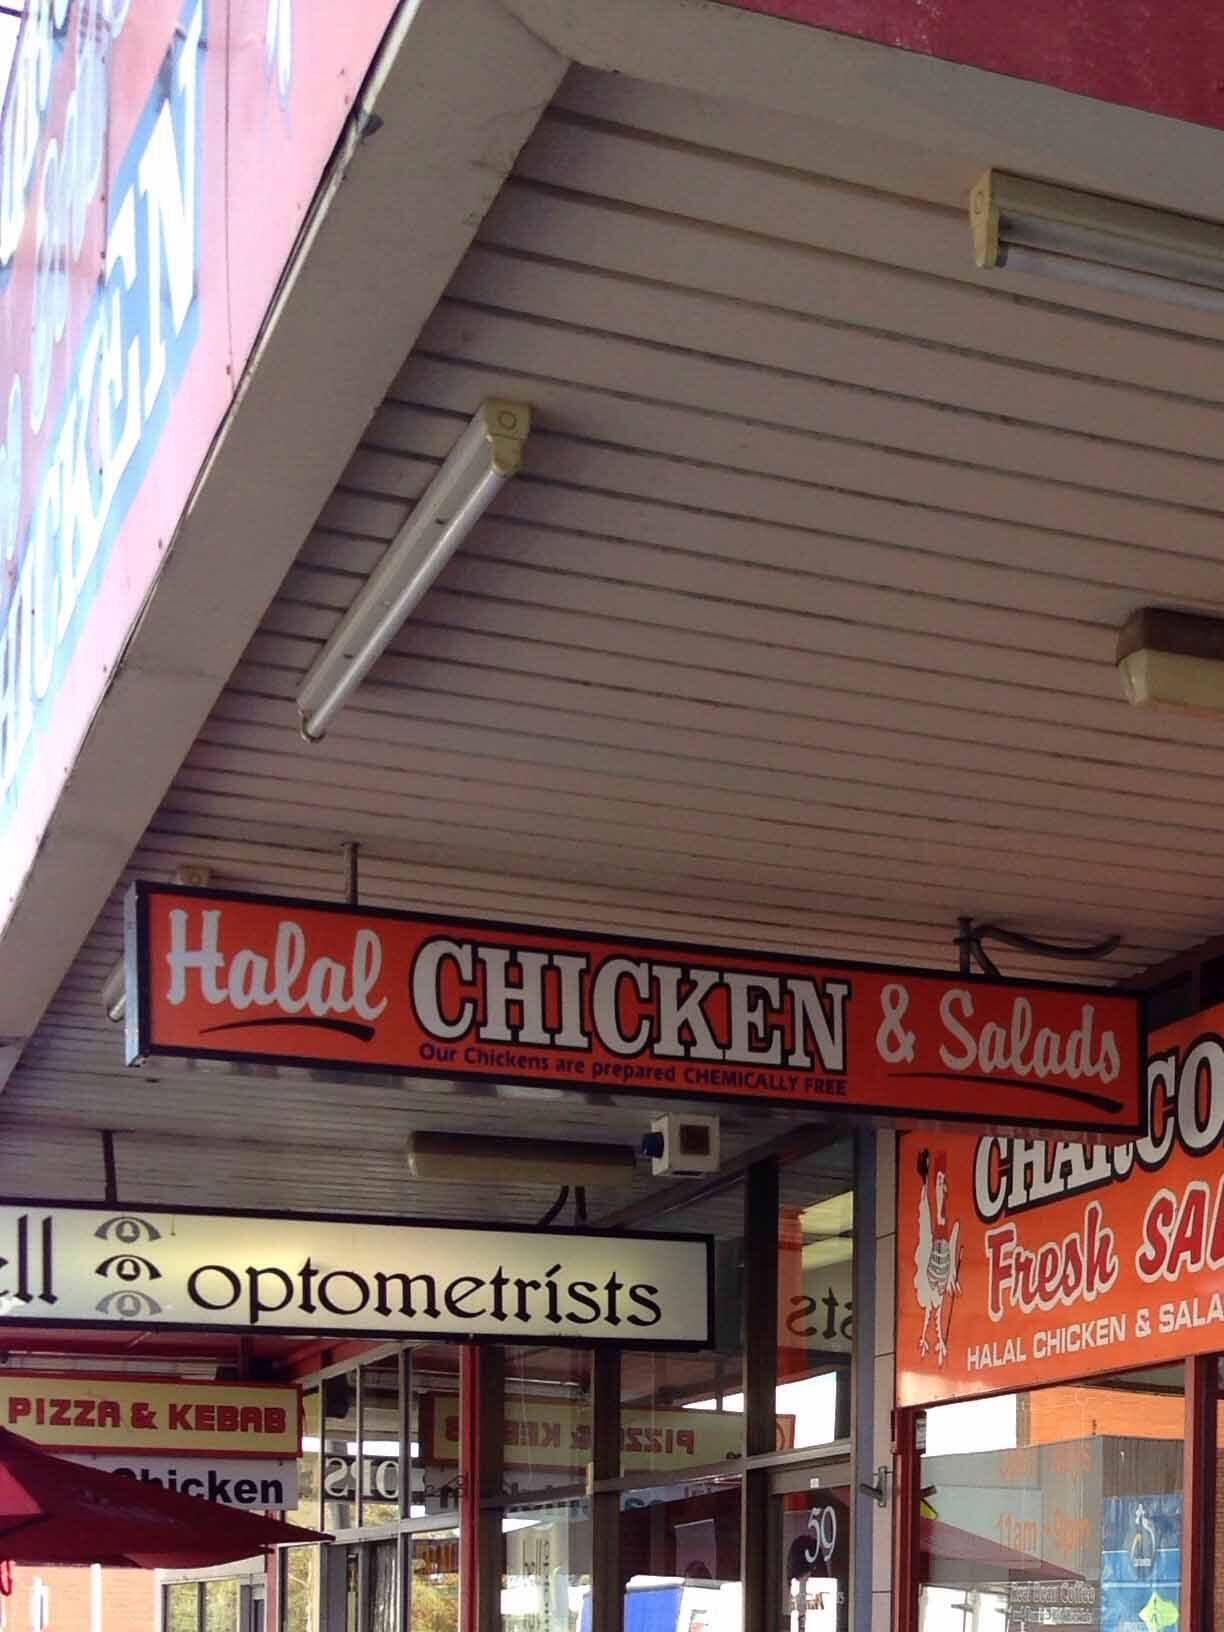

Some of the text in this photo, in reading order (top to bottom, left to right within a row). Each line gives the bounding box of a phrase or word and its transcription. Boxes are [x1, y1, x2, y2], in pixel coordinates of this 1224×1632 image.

[167, 909, 1120, 1083] Halal CHICKEN & Salads
[420, 1044, 846, 1096] Our Chickens are prepared CHEMICALLY FREE
[985, 1202, 1118, 1321] Fresh
[967, 1338, 1026, 1372] HALAL
[1033, 1313, 1127, 1359] CHICKEN
[1135, 1309, 1151, 1338] &
[9, 1397, 286, 1435] PIZZA & KEBAB
[803, 1505, 838, 1564] 59
